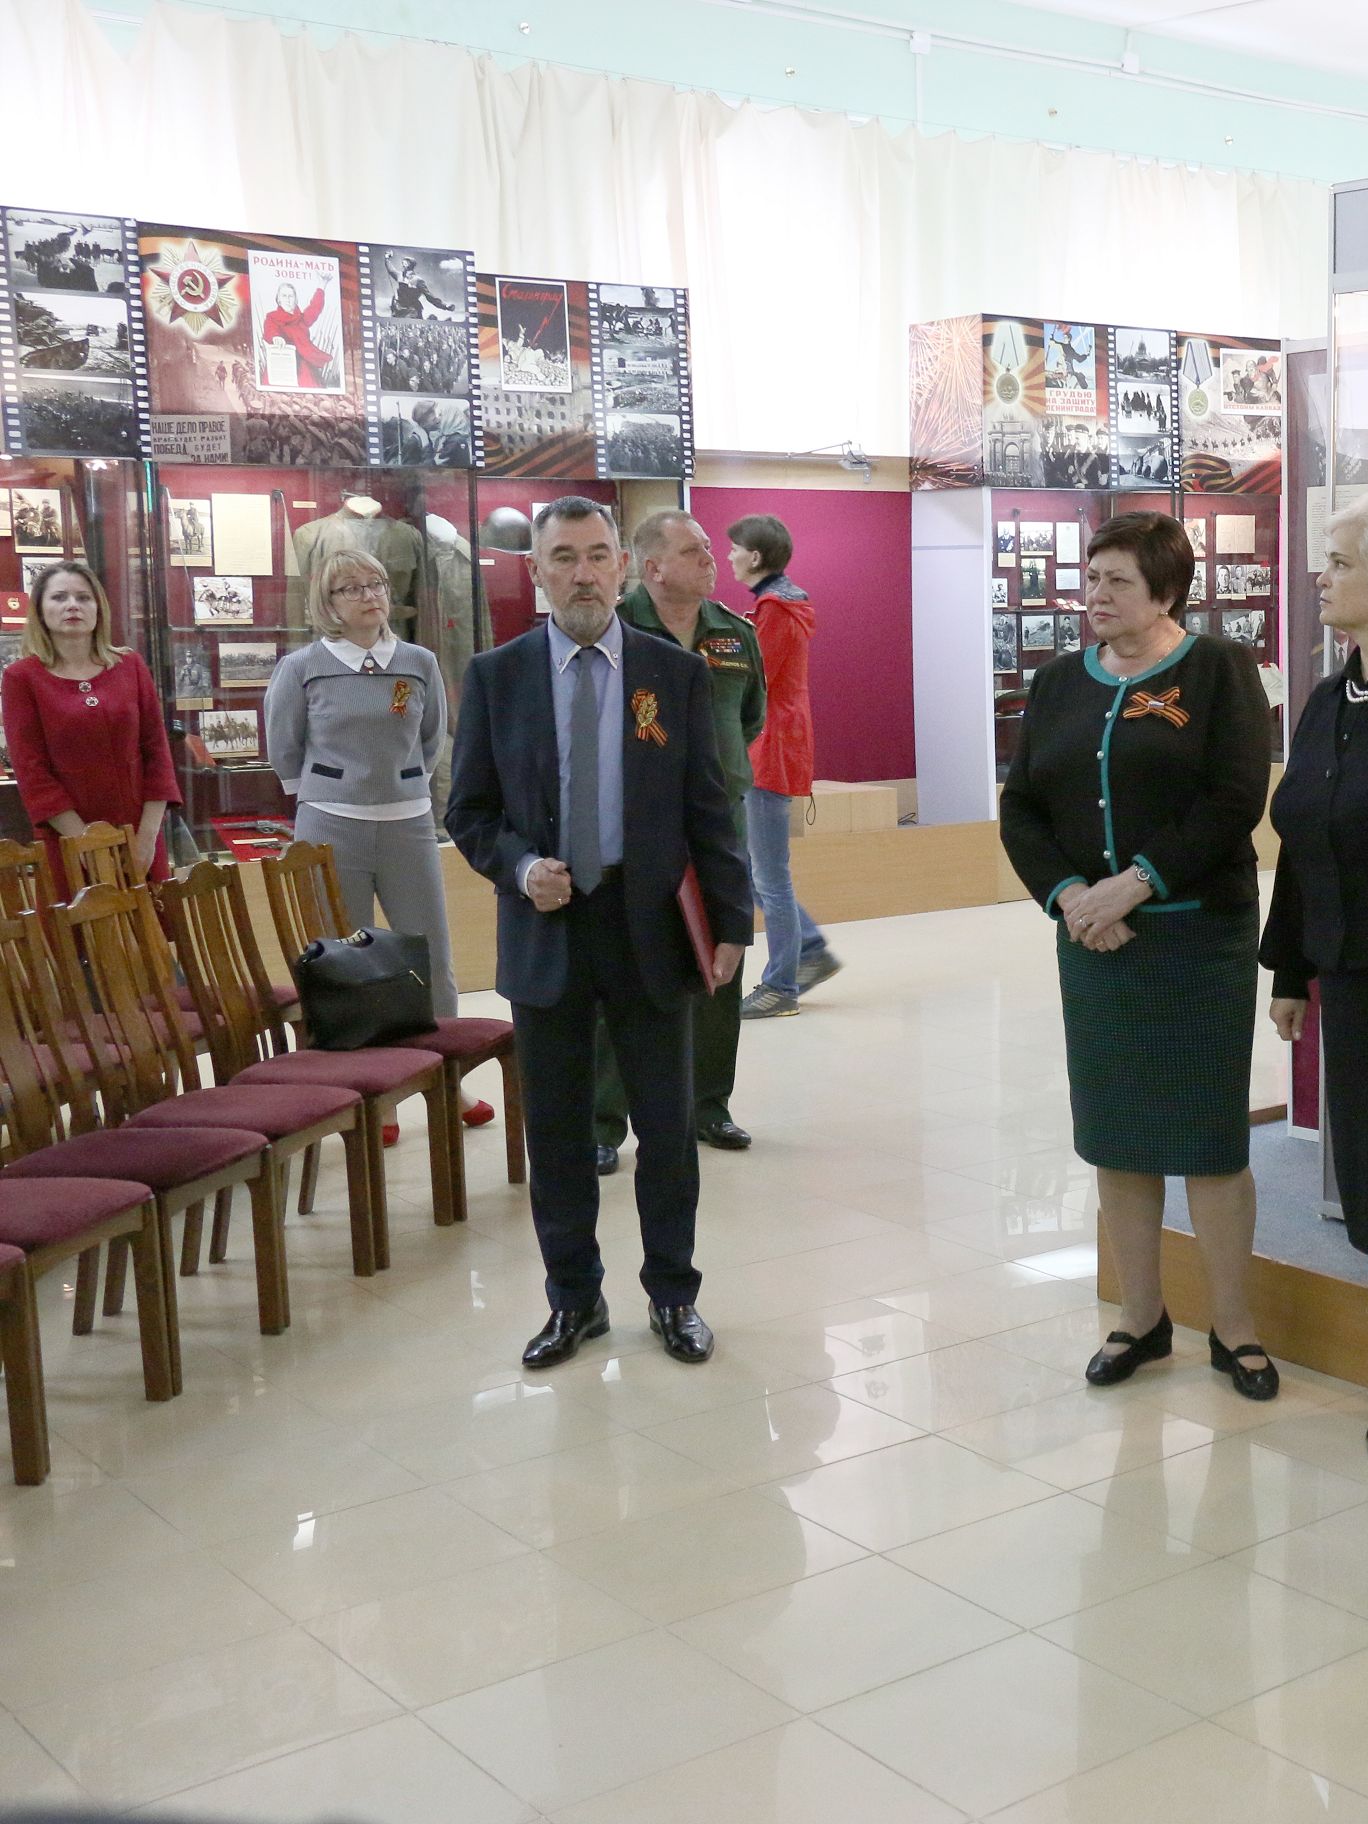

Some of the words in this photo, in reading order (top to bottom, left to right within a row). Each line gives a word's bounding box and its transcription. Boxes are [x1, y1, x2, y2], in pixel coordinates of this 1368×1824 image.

[253, 255, 335, 272] РОДИНА-МАТЬ
[274, 269, 313, 280] ЗОВЕТ!
[1050, 390, 1092, 398] ГРУДЬЮ
[1060, 397, 1096, 405] ЗАЩИТУ
[151, 421, 175, 434] НАШЕ
[176, 421, 197, 435] ДЕЛО
[199, 420, 226, 433] ПРАВОЕ
[194, 443, 221, 452] БУДЕТ
[190, 454, 202, 463] ЗА
[204, 452, 229, 463] НАМИ!
